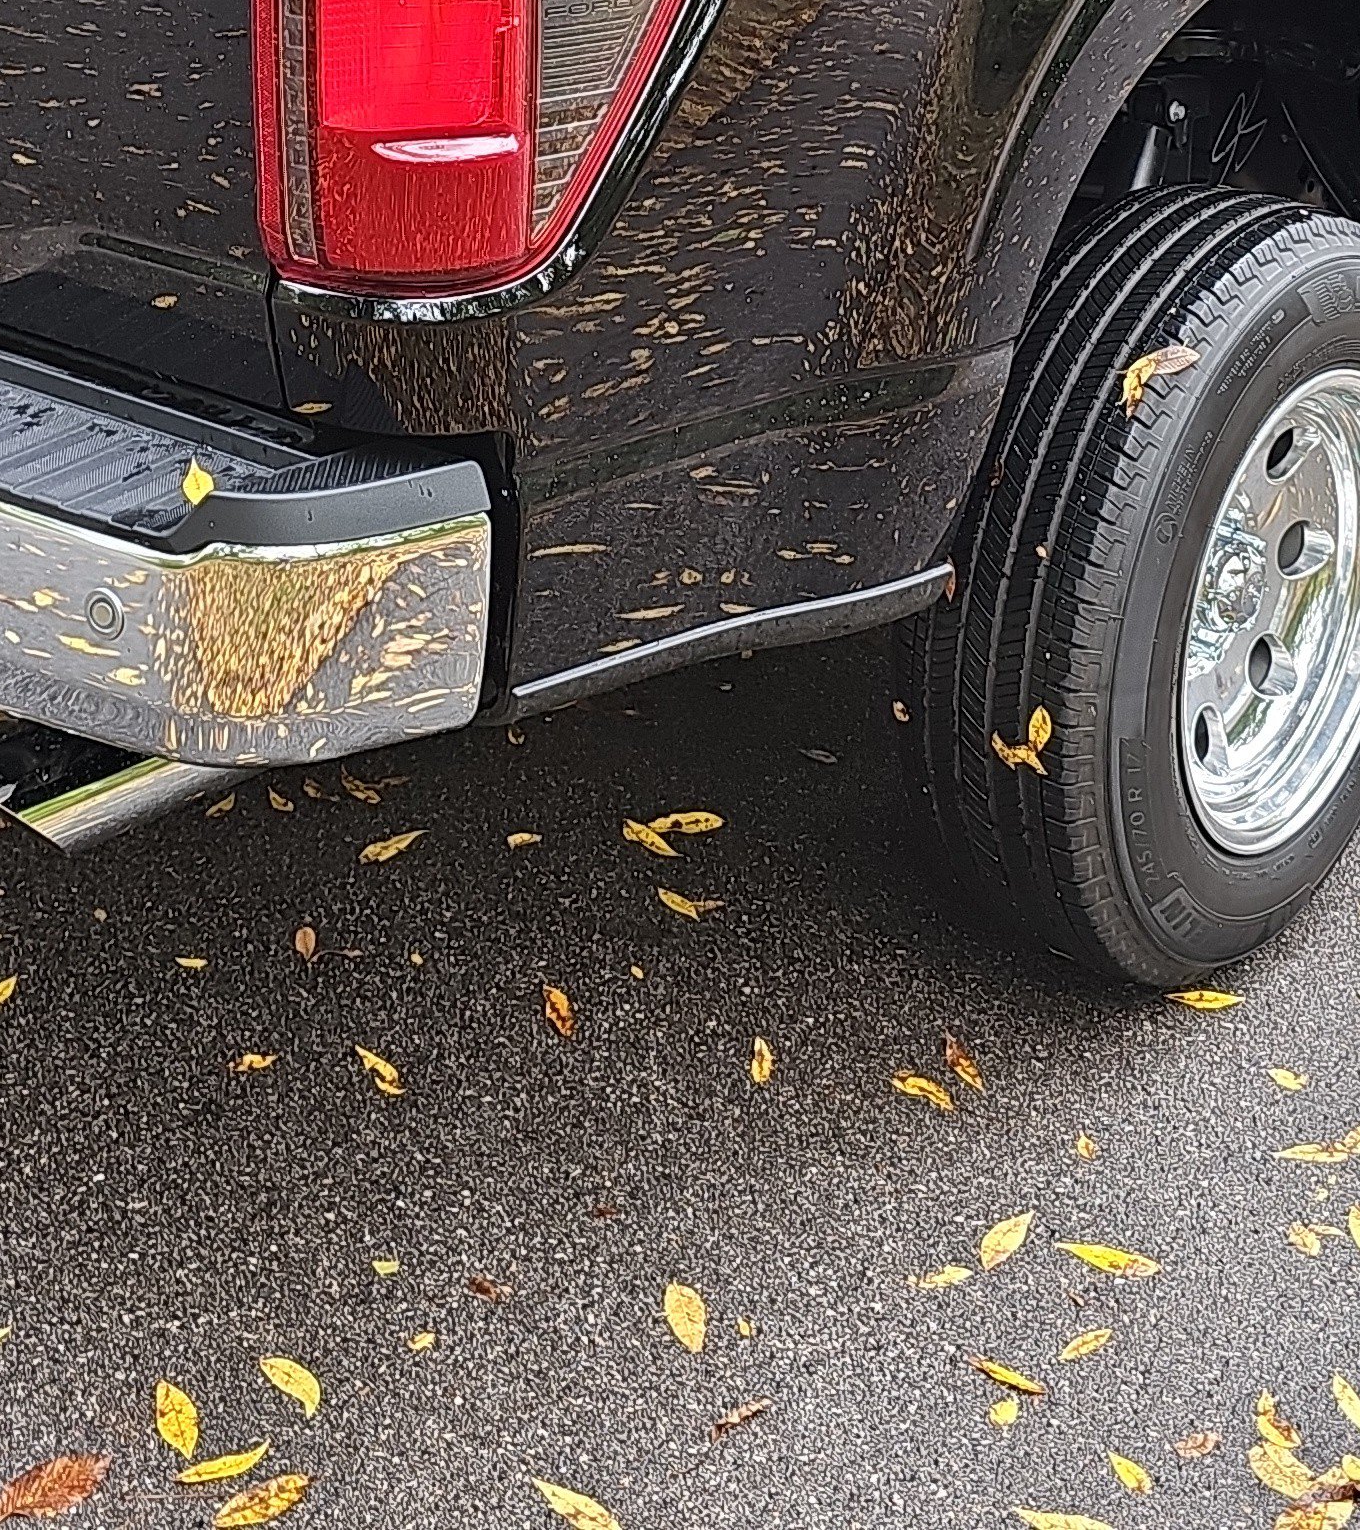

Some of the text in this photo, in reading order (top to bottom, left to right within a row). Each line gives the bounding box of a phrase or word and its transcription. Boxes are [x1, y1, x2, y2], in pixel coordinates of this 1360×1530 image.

[1126, 753, 1159, 886] 245/70 R 17
